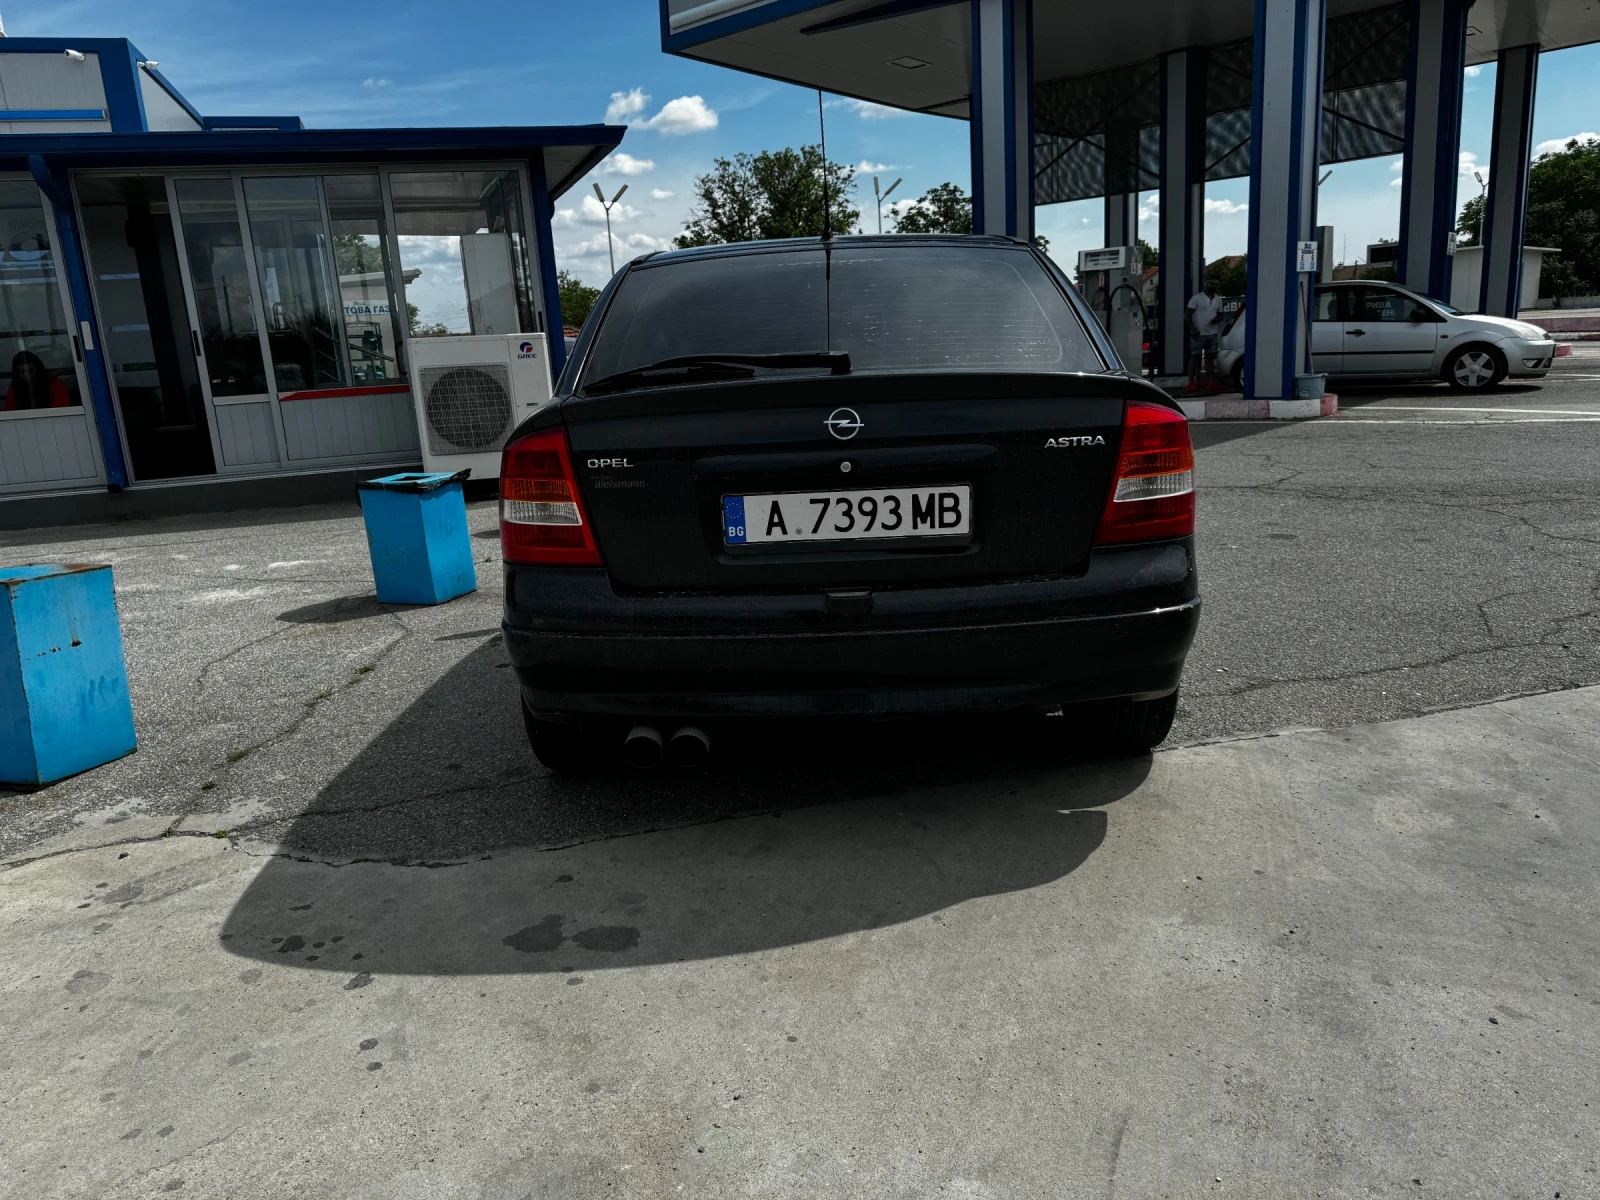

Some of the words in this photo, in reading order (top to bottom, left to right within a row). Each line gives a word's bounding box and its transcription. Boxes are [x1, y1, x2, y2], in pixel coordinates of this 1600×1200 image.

[344, 306, 371, 315] ТОВА
[373, 305, 391, 314] ГАЗ
[1366, 301, 1392, 309] РИВА
[1043, 435, 1106, 449] ASTRA
[587, 458, 634, 468] OPEL
[765, 500, 788, 536] A
[809, 495, 903, 534] 7393
[911, 492, 962, 530] MB
[728, 526, 744, 537] BG
